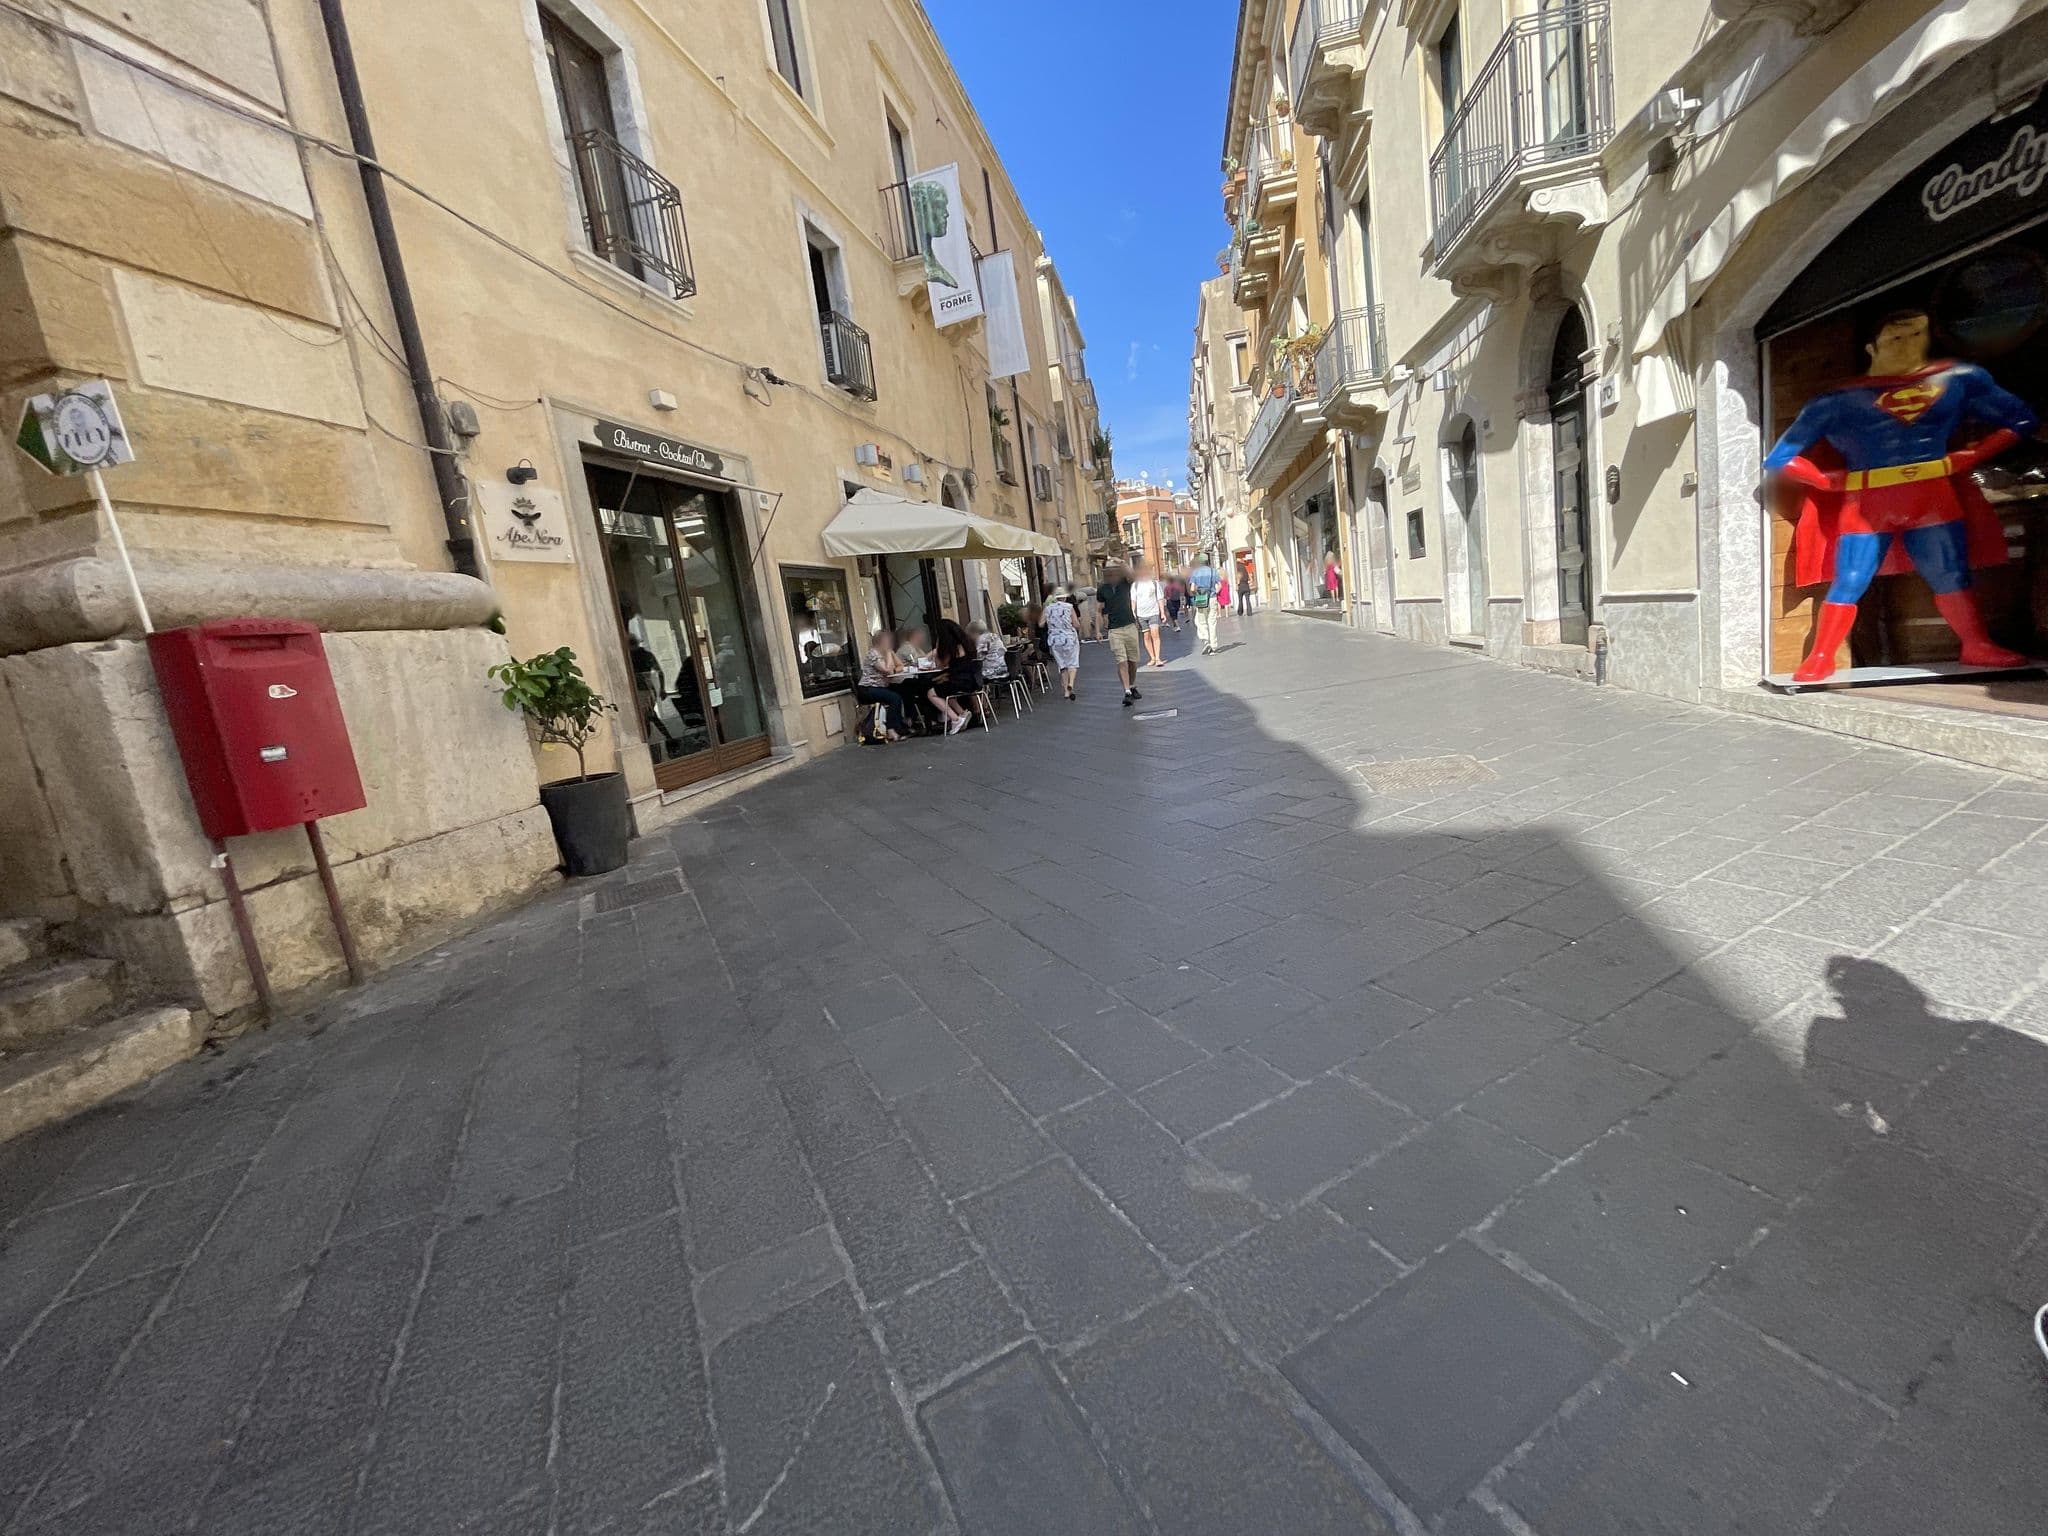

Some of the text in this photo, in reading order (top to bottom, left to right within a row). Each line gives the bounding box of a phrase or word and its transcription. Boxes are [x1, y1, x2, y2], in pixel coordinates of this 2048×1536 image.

[940, 294, 973, 311] FORME
[613, 429, 652, 454] Bistrot
[497, 527, 564, 548] Ape Nera
